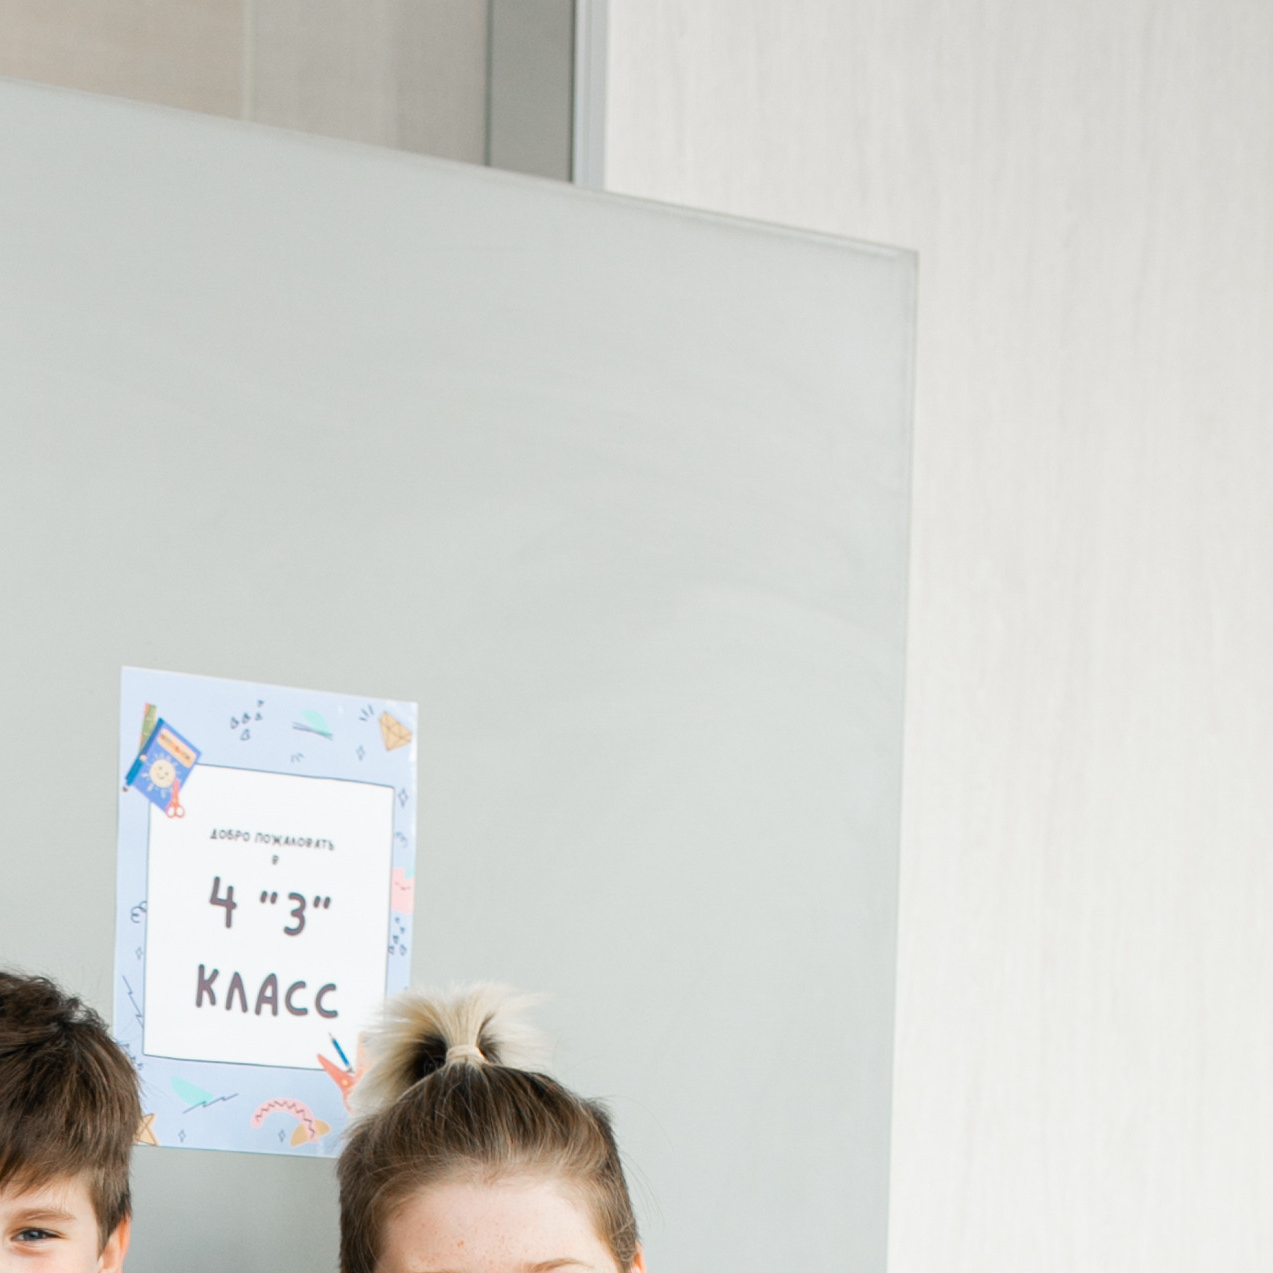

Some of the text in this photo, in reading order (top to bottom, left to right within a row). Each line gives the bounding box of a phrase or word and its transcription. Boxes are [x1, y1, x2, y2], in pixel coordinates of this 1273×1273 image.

[210, 828, 335, 851] ДОБРО ПОЖАЛОВАТЬ
[209, 876, 237, 929] 4
[195, 963, 339, 1019] КЛАСС
